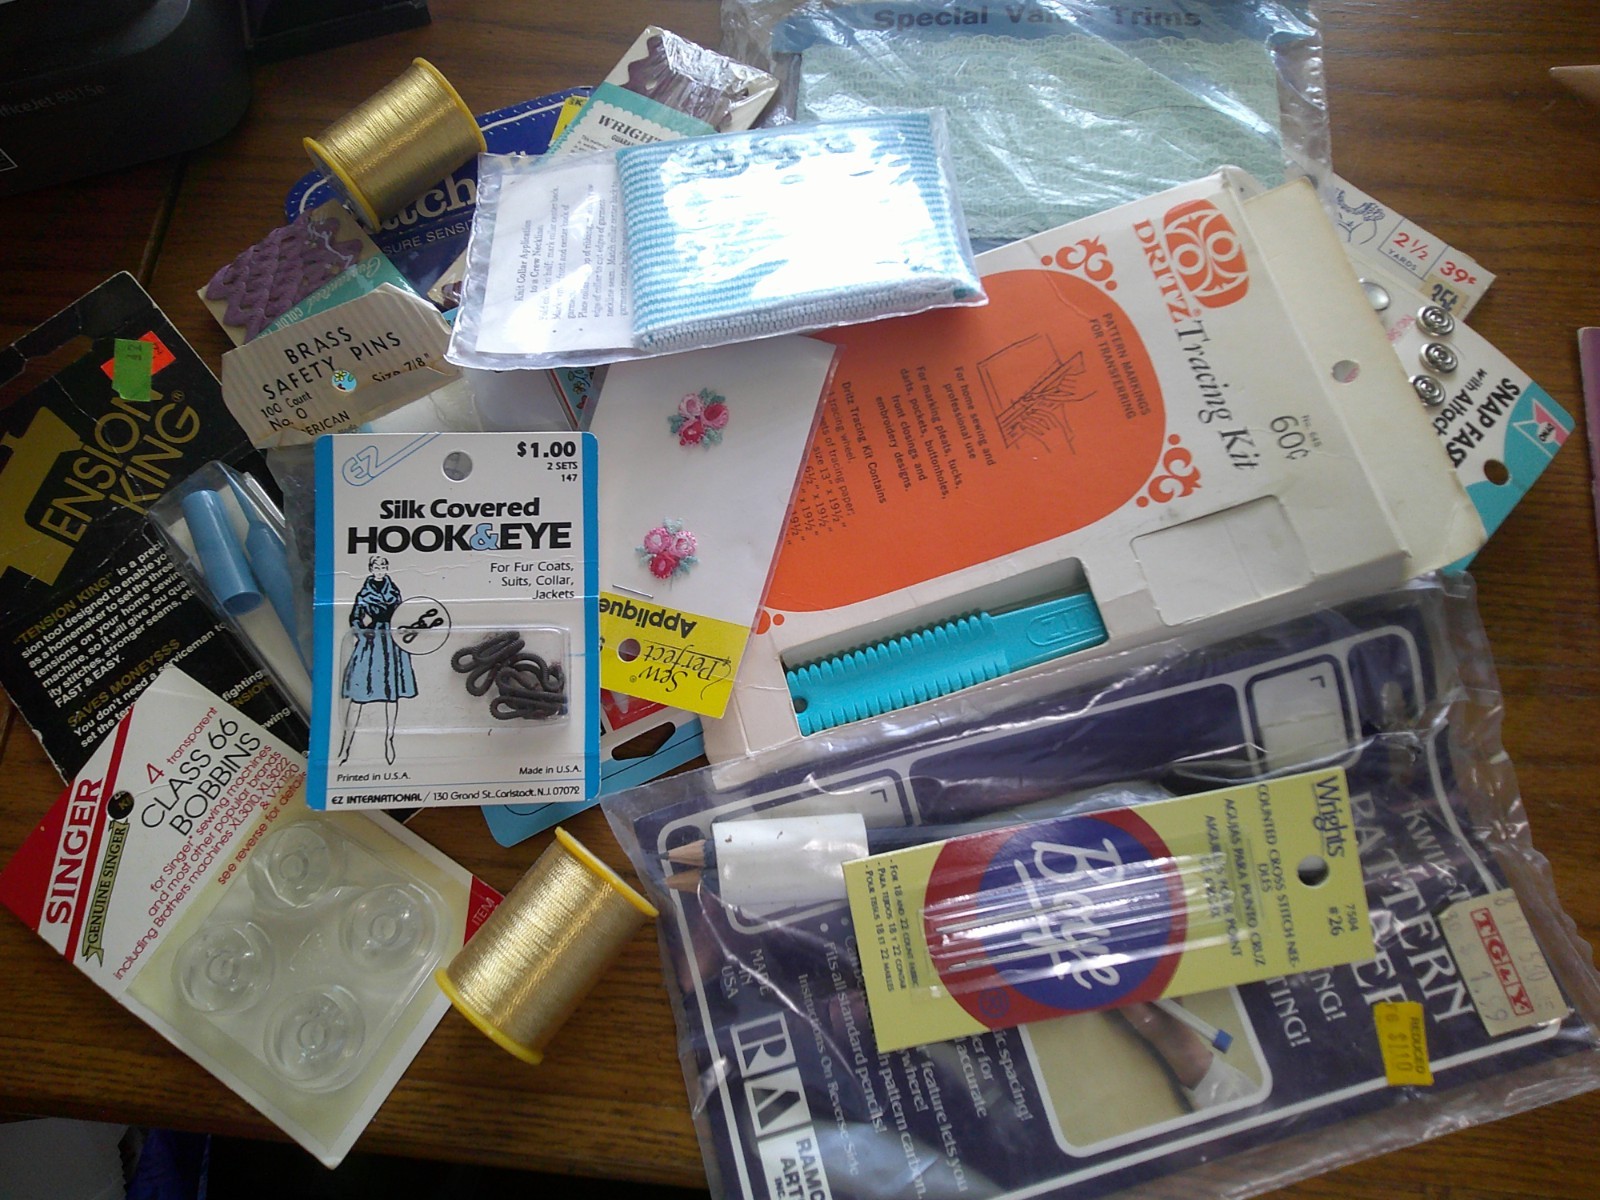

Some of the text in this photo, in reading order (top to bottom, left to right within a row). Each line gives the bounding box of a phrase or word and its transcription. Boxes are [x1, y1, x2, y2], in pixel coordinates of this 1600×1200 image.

[874, 5, 1202, 30] Special Trims
[517, 259, 528, 284] Collar
[532, 251, 541, 275] Crew
[1132, 219, 1193, 323] DRITZ
[262, 331, 401, 400] SAFETY PINS
[285, 326, 352, 365] BRASS
[1089, 319, 1136, 420] FOR TRANSFERRING
[1103, 313, 1151, 416] PATTERN MARKINGS
[261, 391, 312, 419] 100 Count
[301, 410, 350, 436] ERICAN
[876, 397, 899, 449] embroidery
[917, 366, 941, 424] For marking
[943, 383, 976, 460] professional use
[954, 366, 996, 467] For home sewing and
[1174, 320, 1259, 470] Tracing Kit
[1478, 378, 1520, 429] SNAP
[108, 403, 201, 516] KING
[517, 441, 576, 458] $1.00
[555, 461, 578, 471] SETS
[841, 381, 886, 504] Dritz Tracing Kit Contains
[891, 395, 927, 481] front closings and
[1270, 415, 1310, 460] 60¢
[561, 474, 578, 482] 147
[925, 440, 951, 500] buttonholes,
[379, 498, 540, 519] Silk Covered
[490, 561, 574, 573] For Fur Coats,
[501, 575, 574, 587] Suits, Collar,
[532, 589, 575, 600] Jackets
[21, 562, 154, 659] sion tool designed enable
[34, 593, 150, 678] tensions on your home
[49, 579, 150, 654] homemaker set the
[599, 598, 698, 639] Applique
[41, 594, 168, 688] machine, will give you
[61, 600, 183, 692] stitches, stronger seams,
[643, 645, 718, 680] Perfect
[54, 656, 125, 708] FAST EASY.
[67, 690, 110, 728] SAVES
[73, 629, 216, 738] You don't need serviceman
[222, 668, 265, 702] fighting
[638, 665, 687, 693] Sew
[80, 717, 116, 748] set the
[146, 706, 219, 785] 4 transparent
[141, 718, 239, 828] CLASS 66
[169, 732, 261, 836] BOBBINS
[331, 786, 580, 805] EZ INTERNATIONAL 130 Grand 07072
[336, 772, 411, 783] Printed U.S.A.
[519, 765, 582, 776] Made U.S.A.
[148, 750, 283, 917] and most other popular brands
[150, 874, 167, 893] for
[195, 797, 230, 836] sewing
[226, 743, 273, 802] machines
[1313, 775, 1349, 858] Wrights
[46, 777, 103, 924] SINGER
[217, 820, 268, 887] see reverse
[1257, 784, 1295, 939] COUNTED CROSS STITCH
[87, 826, 127, 946] GENUINE SINGER
[113, 828, 234, 981] including Brothers machines
[471, 897, 496, 926] ITEM
[1224, 798, 1266, 967] AGUJAS PARA PUNTO CRUZ
[720, 965, 739, 999] USA
[750, 948, 771, 996] MADE
[838, 992, 868, 1066] standard
[1409, 1015, 1427, 1076] REDUCED
[884, 1067, 908, 1132] pattern
[955, 1044, 988, 1119] accurate
[979, 1058, 994, 1082] for
[827, 1081, 850, 1139] Reverse
[920, 1060, 969, 1193] feature lets you
